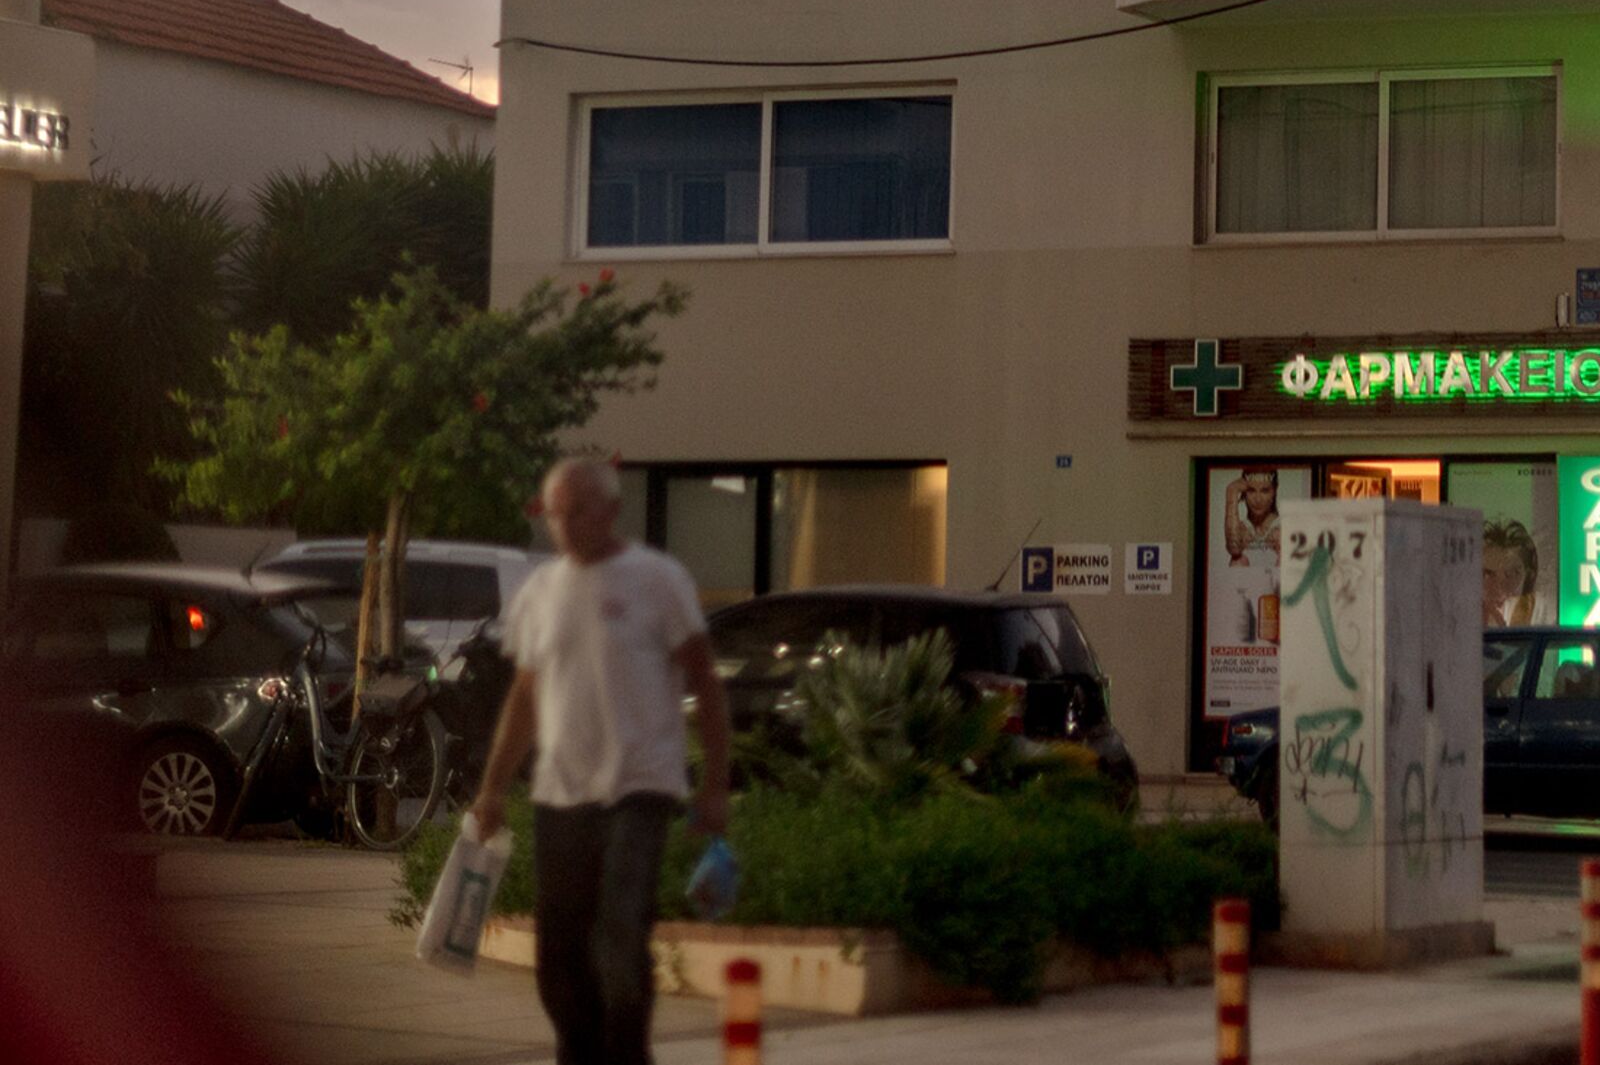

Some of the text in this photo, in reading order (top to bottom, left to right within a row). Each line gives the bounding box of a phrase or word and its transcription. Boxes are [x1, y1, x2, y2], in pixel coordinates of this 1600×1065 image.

[1056, 555, 1109, 568] PARKING
[1143, 550, 1154, 566] P
[1027, 555, 1047, 584] P
[1056, 574, 1109, 587] ΠΕΛΑΤΩΝ
